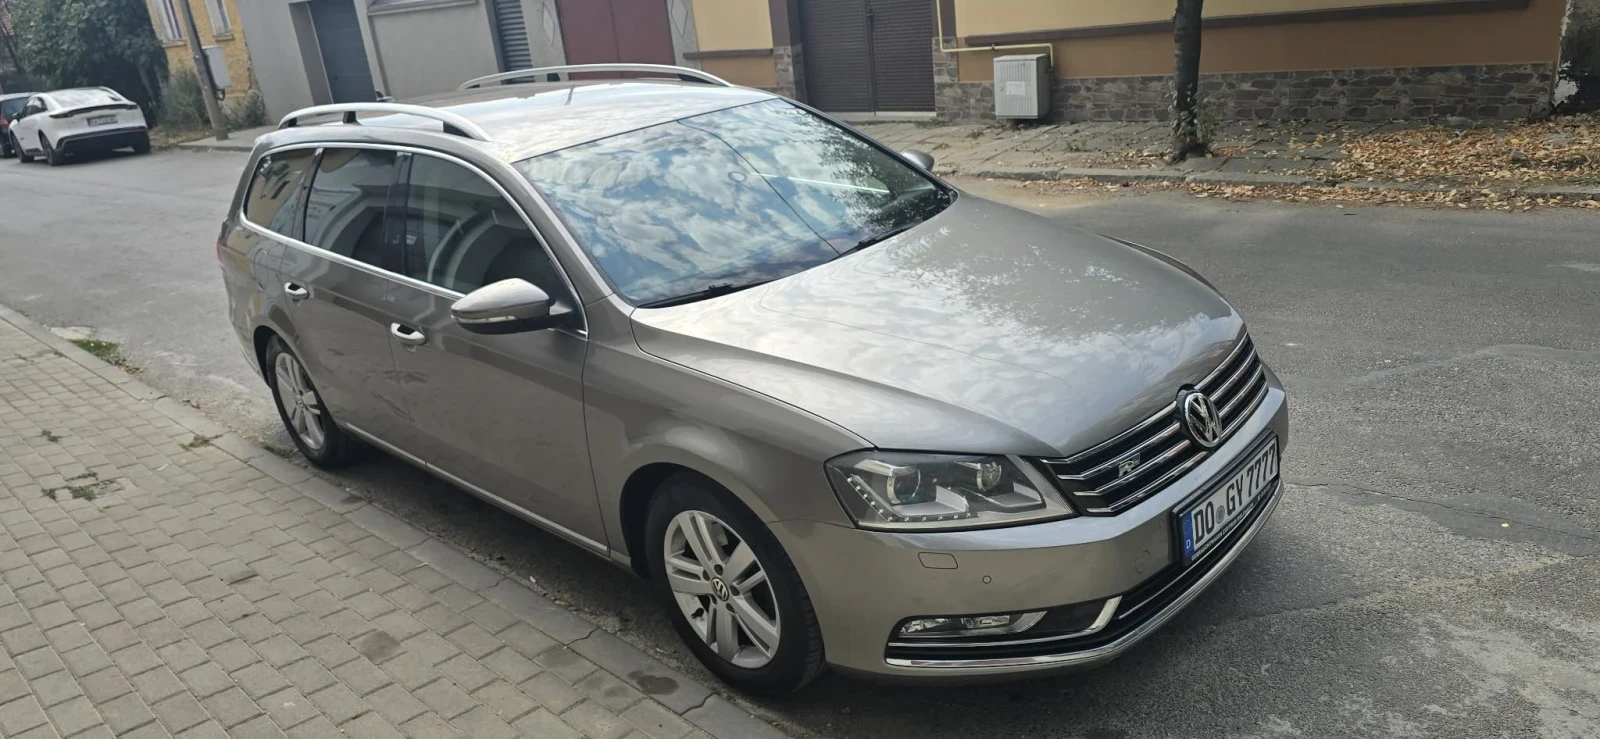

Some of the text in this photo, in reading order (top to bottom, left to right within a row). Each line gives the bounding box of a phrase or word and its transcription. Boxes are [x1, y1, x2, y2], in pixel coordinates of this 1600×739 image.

[1193, 501, 1215, 545] DO
[1226, 474, 1243, 516] GY
[1246, 443, 1275, 497] 7777
[1186, 539, 1191, 549] D
